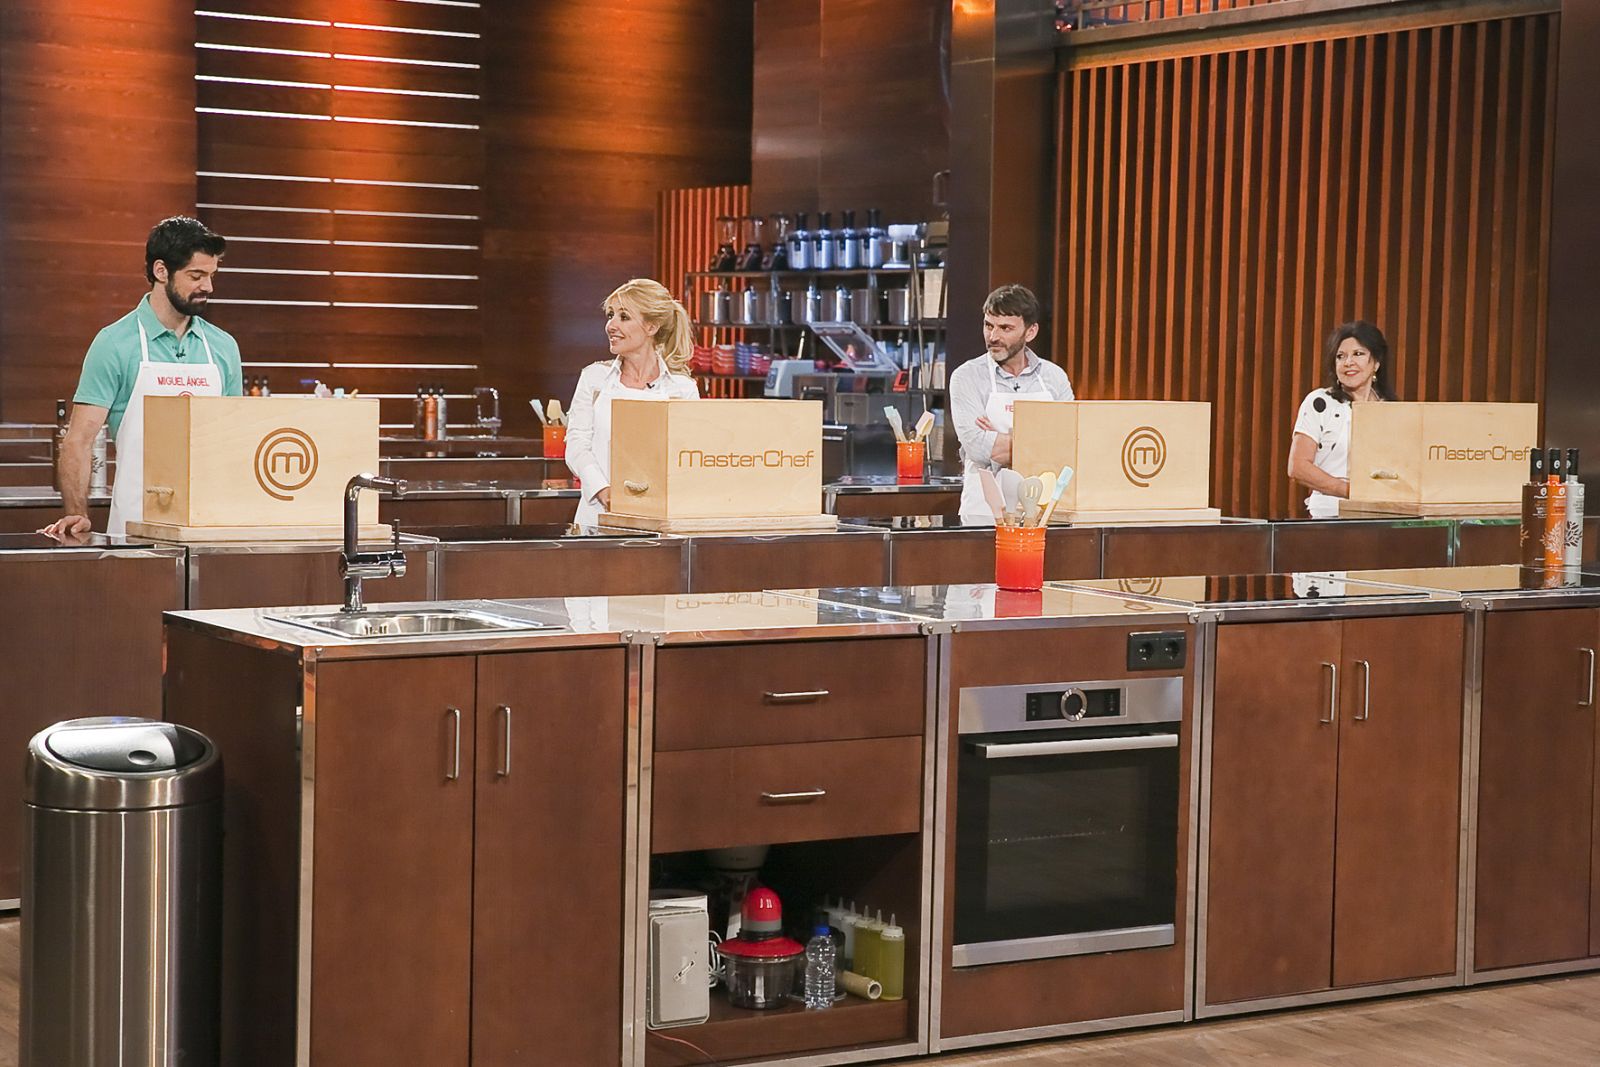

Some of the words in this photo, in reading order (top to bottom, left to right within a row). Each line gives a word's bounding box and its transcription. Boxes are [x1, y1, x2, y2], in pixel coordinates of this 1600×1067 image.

[157, 376, 185, 386] MIGUEL
[187, 375, 210, 387] ÁNGEL
[678, 450, 814, 467] MasterChef
[1428, 445, 1530, 461] MasterChef
